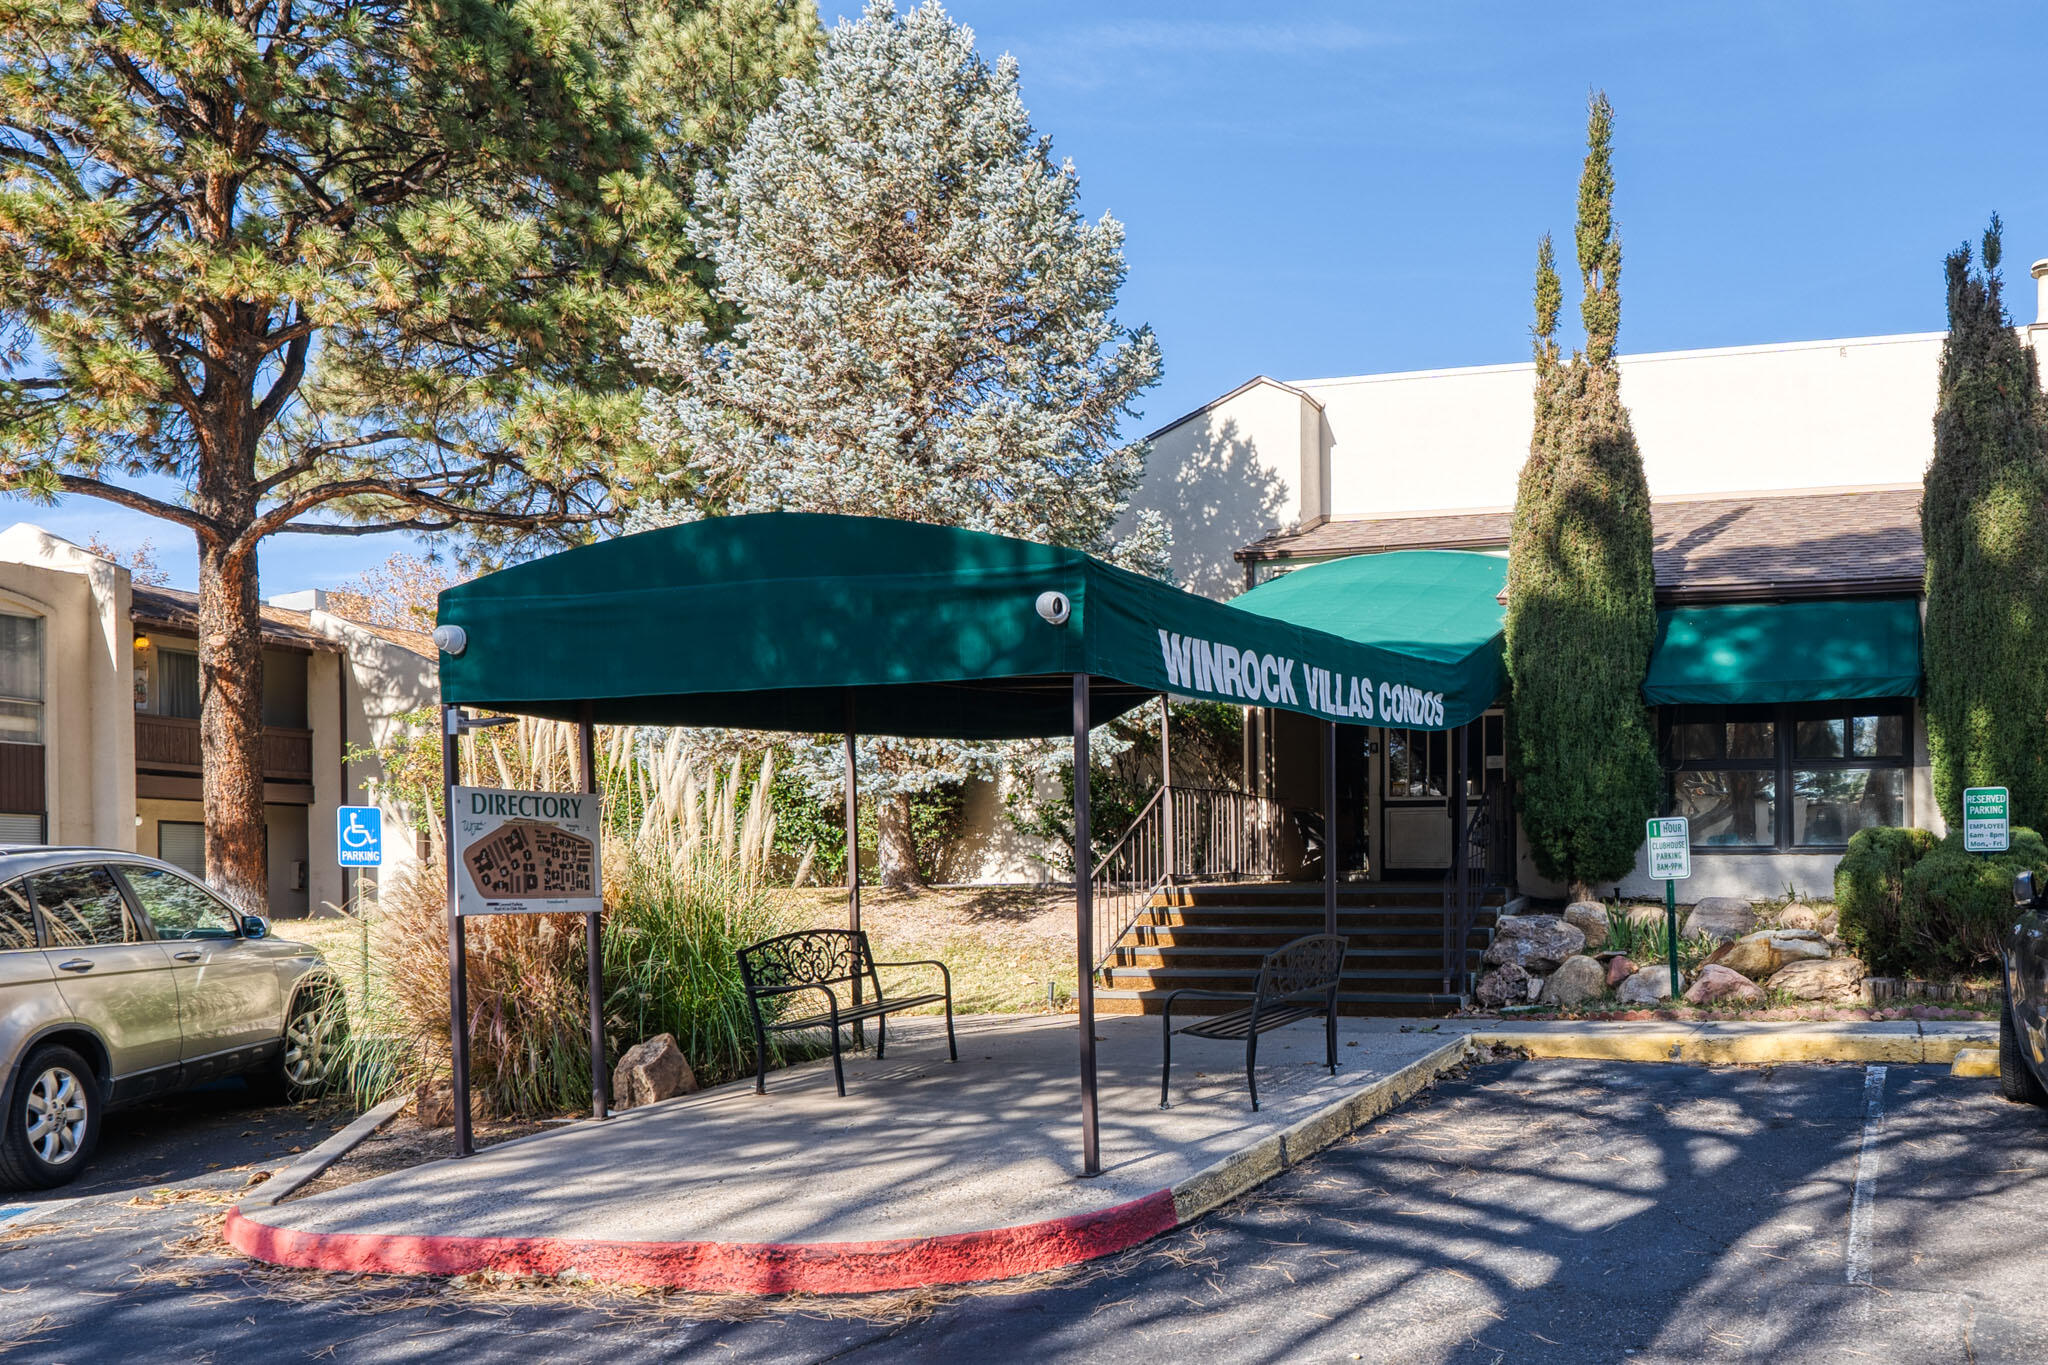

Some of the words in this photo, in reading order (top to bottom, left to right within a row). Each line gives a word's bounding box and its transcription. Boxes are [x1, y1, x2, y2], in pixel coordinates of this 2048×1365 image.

[1158, 628, 1299, 706] WINROCK
[1303, 662, 1374, 720] VILLAS
[1379, 681, 1444, 727] CONDOS
[1967, 794, 2006, 804] RESERVED
[472, 793, 582, 819] DIRECTORY
[1970, 805, 2004, 815] PARKING
[1653, 822, 1658, 837] 1
[1663, 823, 1682, 833] HOUR
[1652, 840, 1685, 850] CLUBHOUSE
[342, 850, 380, 862] PARKING
[1656, 851, 1682, 861] PARKING
[1656, 862, 1683, 871] 8AM-9PM
